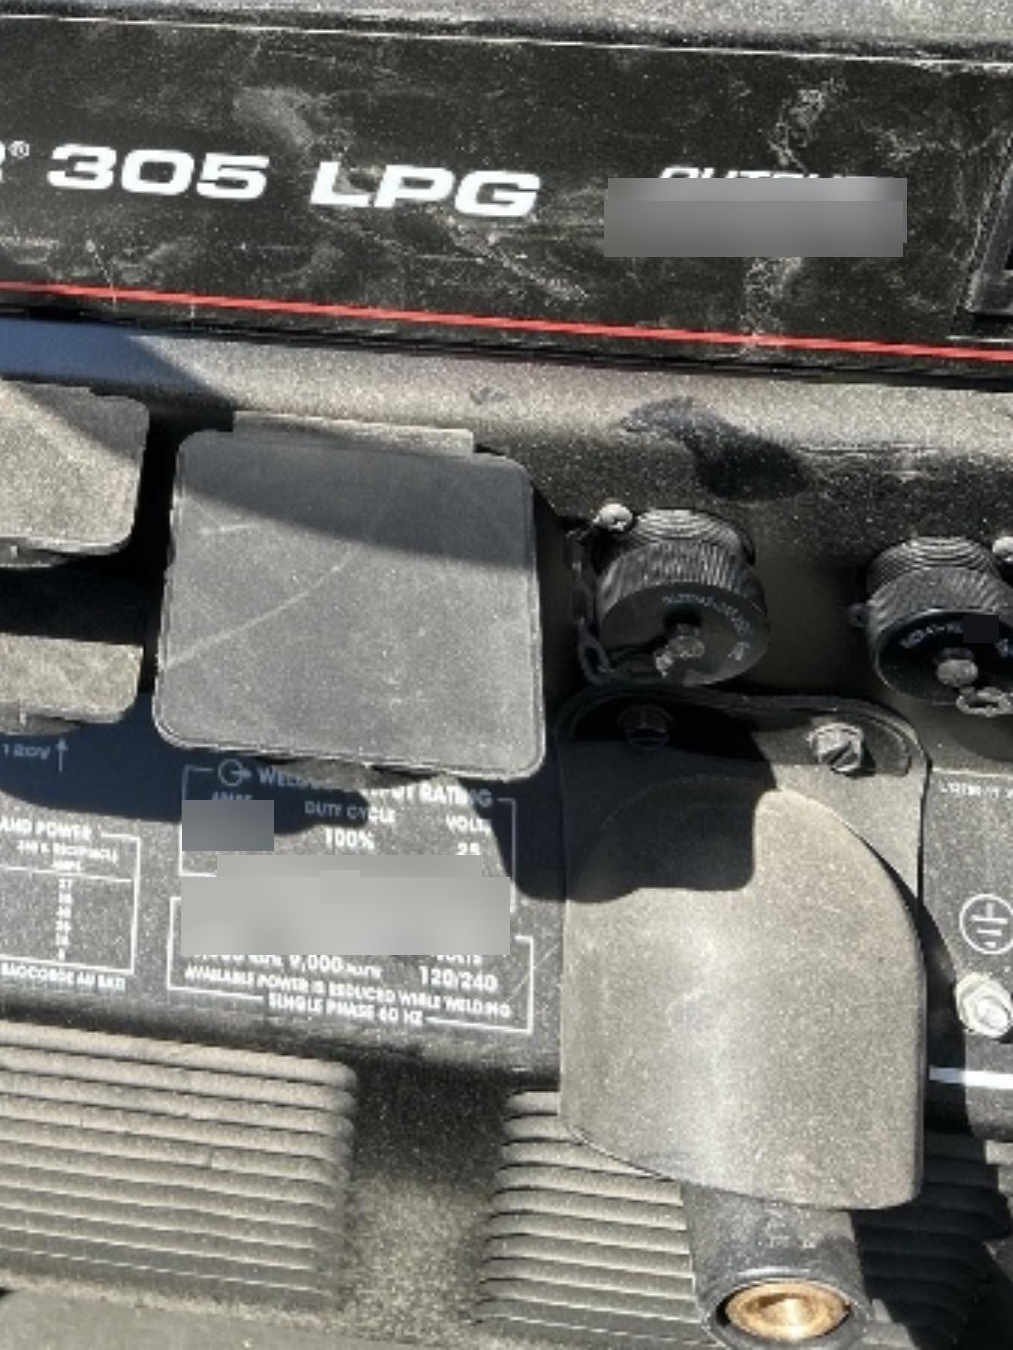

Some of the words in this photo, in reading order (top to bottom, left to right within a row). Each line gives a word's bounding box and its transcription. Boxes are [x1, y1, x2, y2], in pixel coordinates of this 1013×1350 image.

[46, 143, 270, 200] 305
[310, 160, 541, 218] LPG
[347, 806, 396, 824] CYCLE
[323, 827, 374, 851] 100%
[419, 964, 499, 993] 120/240
